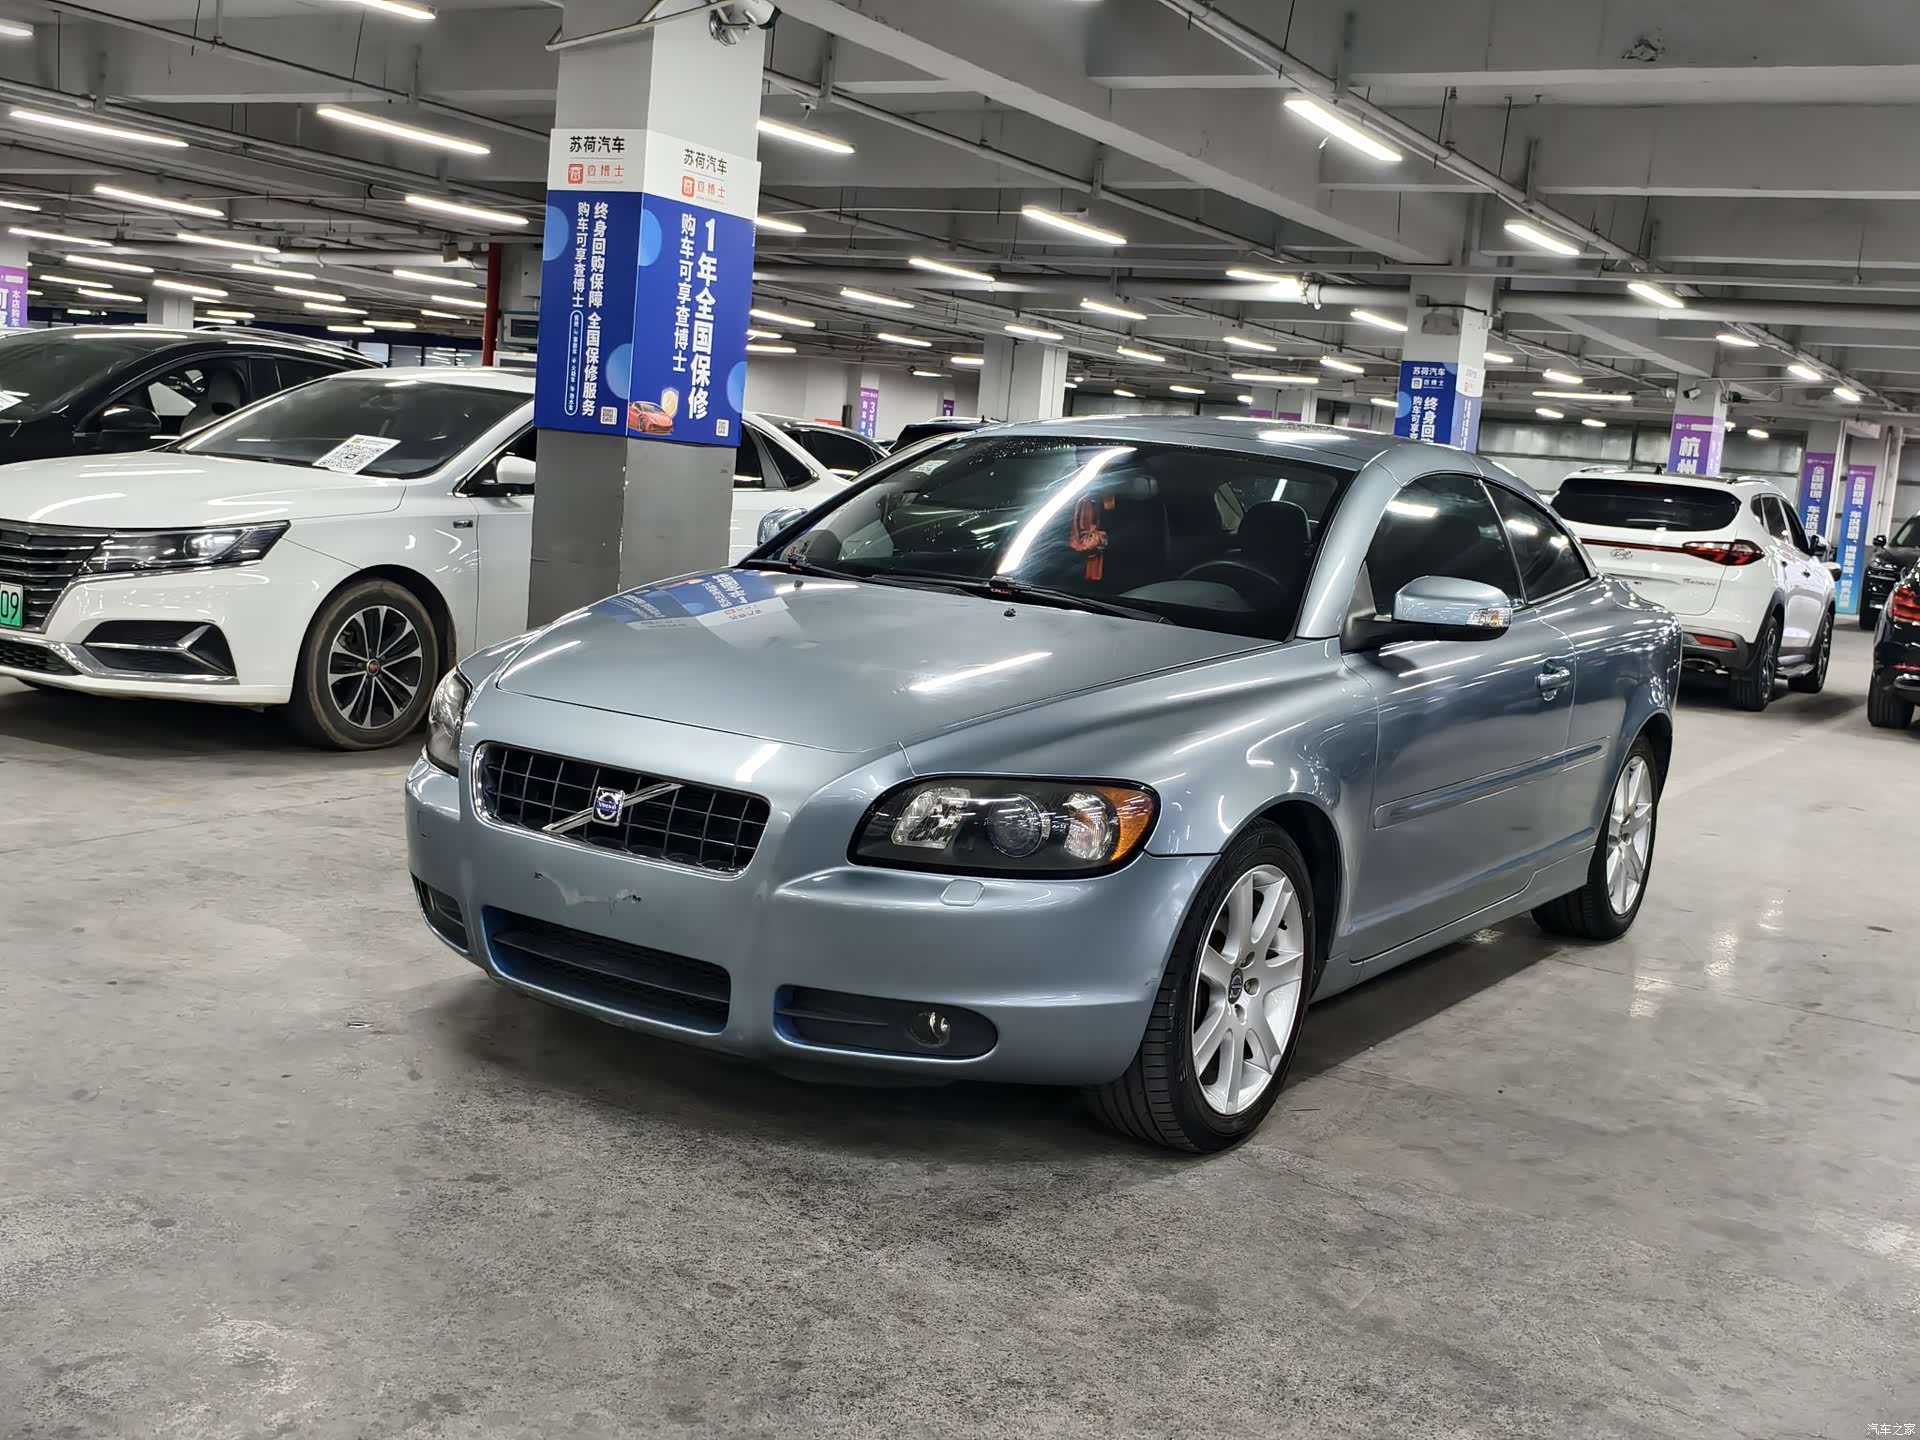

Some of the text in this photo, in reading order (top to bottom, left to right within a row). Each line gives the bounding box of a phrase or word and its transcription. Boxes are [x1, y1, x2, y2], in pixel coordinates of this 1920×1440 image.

[569, 136, 625, 153] 苏荷汽车
[683, 148, 728, 175] 苏荷汽车
[572, 201, 590, 308] 购车可享查博士
[589, 202, 608, 308] 终身回购保障
[672, 213, 697, 373] 购车可享查博士
[581, 312, 602, 417] 全国保修服务
[687, 218, 718, 420] 1年全国保修
[1412, 366, 1446, 377] 苏荷汽车
[0, 590, 20, 620] 09
